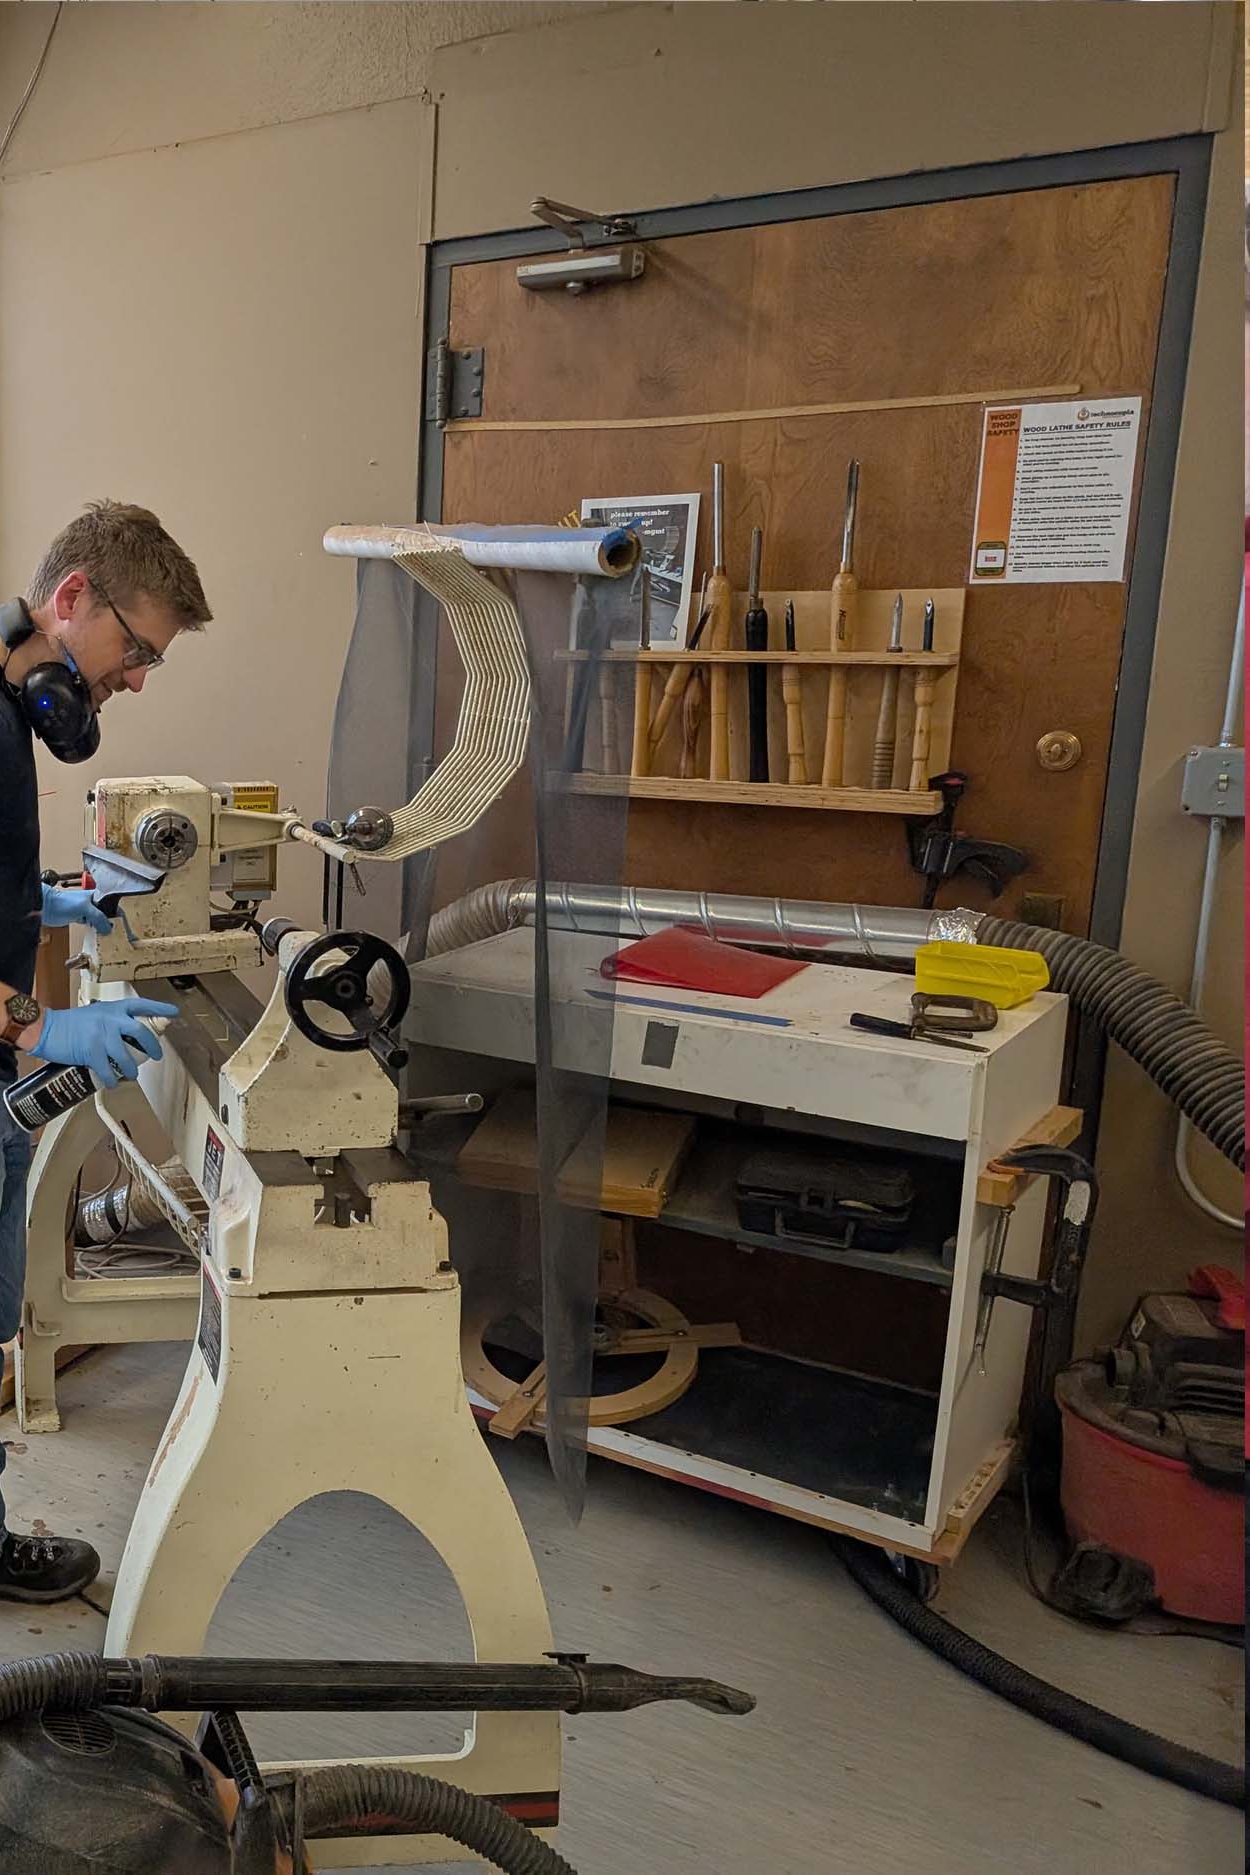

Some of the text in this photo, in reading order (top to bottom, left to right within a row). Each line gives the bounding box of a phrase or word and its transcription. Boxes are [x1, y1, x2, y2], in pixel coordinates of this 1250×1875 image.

[990, 413, 1018, 421] WOOD
[991, 421, 1015, 429] SHOP
[1106, 420, 1131, 428] RULES
[610, 510, 633, 519] please
[641, 519, 654, 527] up!
[207, 1142, 222, 1166] JET
